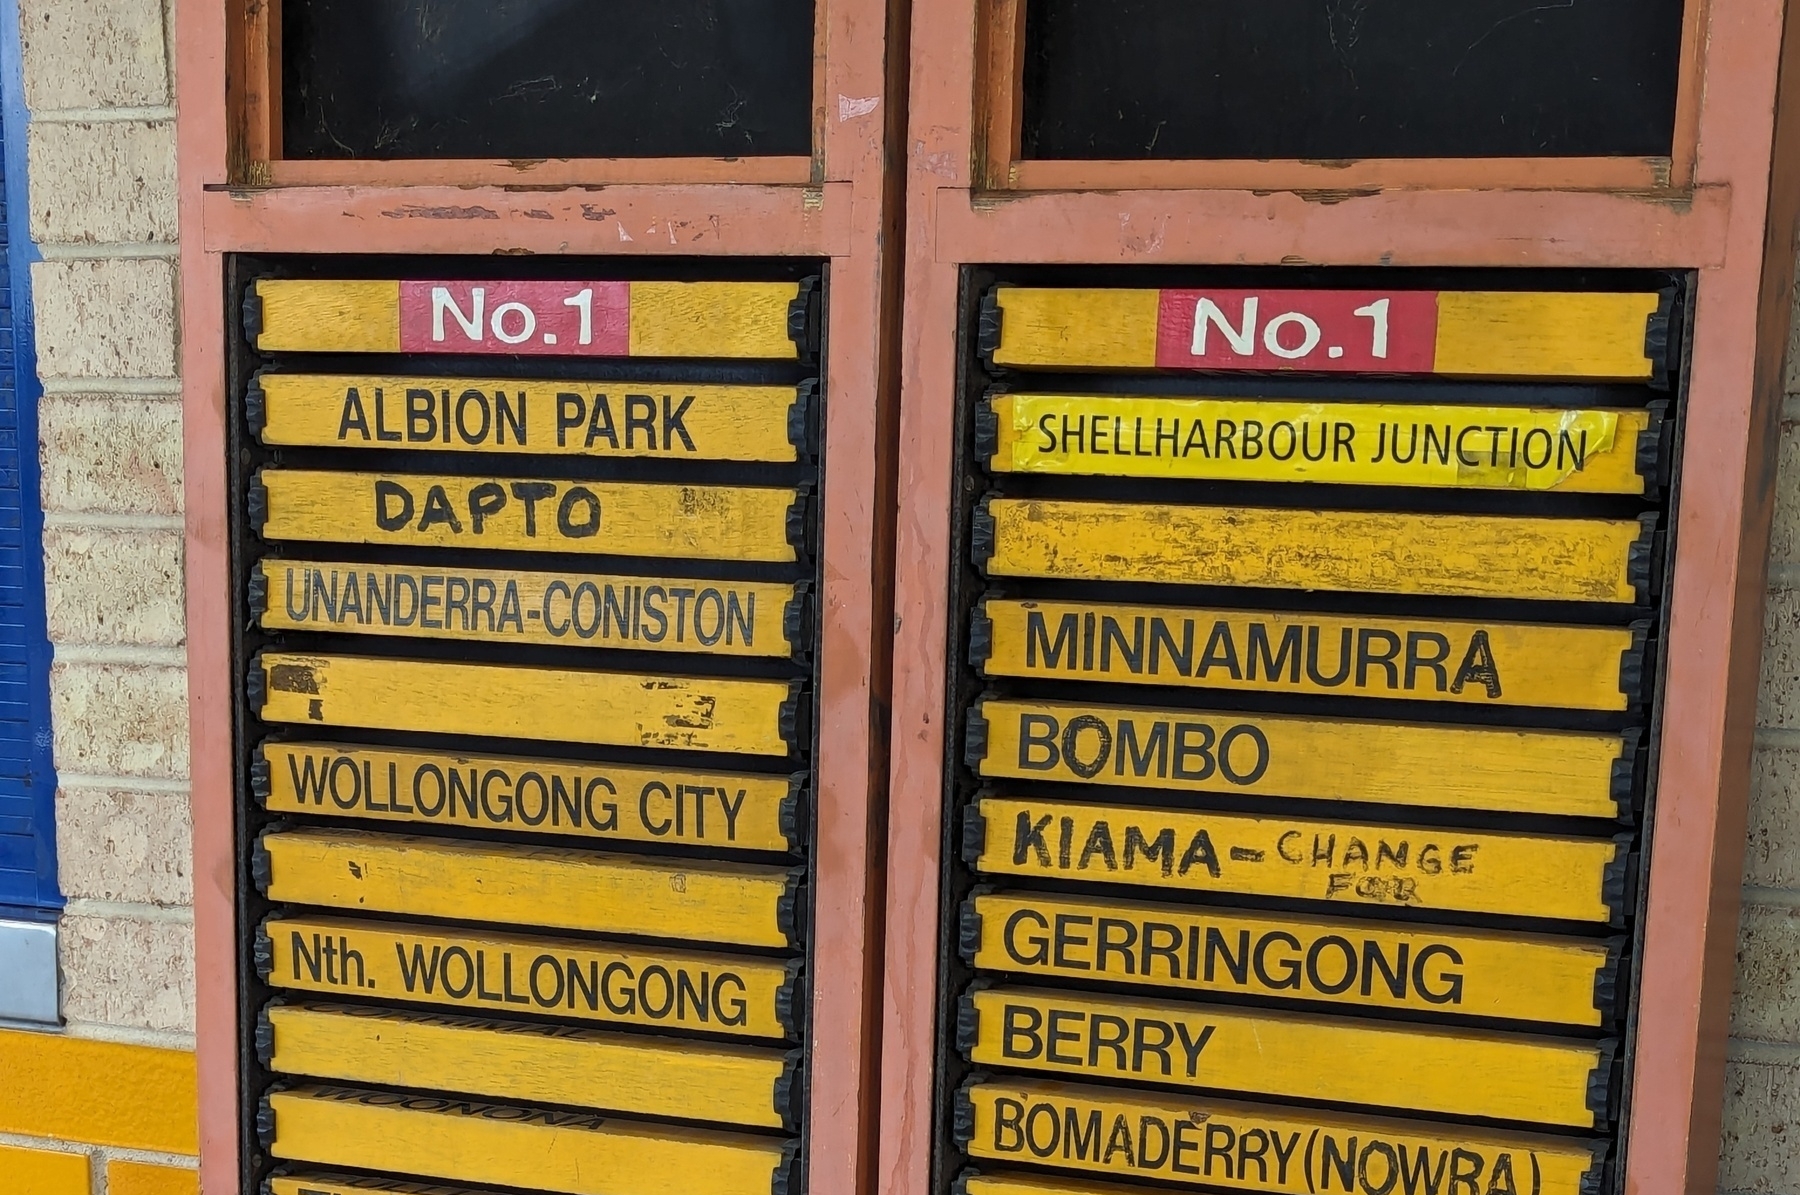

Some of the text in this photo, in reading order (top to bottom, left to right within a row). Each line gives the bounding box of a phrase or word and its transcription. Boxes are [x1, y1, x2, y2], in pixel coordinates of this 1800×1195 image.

[431, 286, 594, 345] No.1
[1190, 297, 1390, 360] No.1
[338, 387, 697, 452] ALBION PARK
[1037, 413, 1587, 472] SHELLHARBOUR JUNCTION
[375, 480, 602, 538] DAPTO
[286, 568, 756, 647] UNANDERRA-CONISTON
[1026, 612, 1502, 700] MINNAMURRA
[1018, 714, 1270, 786] BOMBO
[287, 754, 747, 842] WOLLONGONG CITY
[290, 931, 748, 1027] Nth. WOLLONGONG
[1003, 908, 1464, 1005] GERRINGONG
[1001, 1003, 1217, 1077] BERRY
